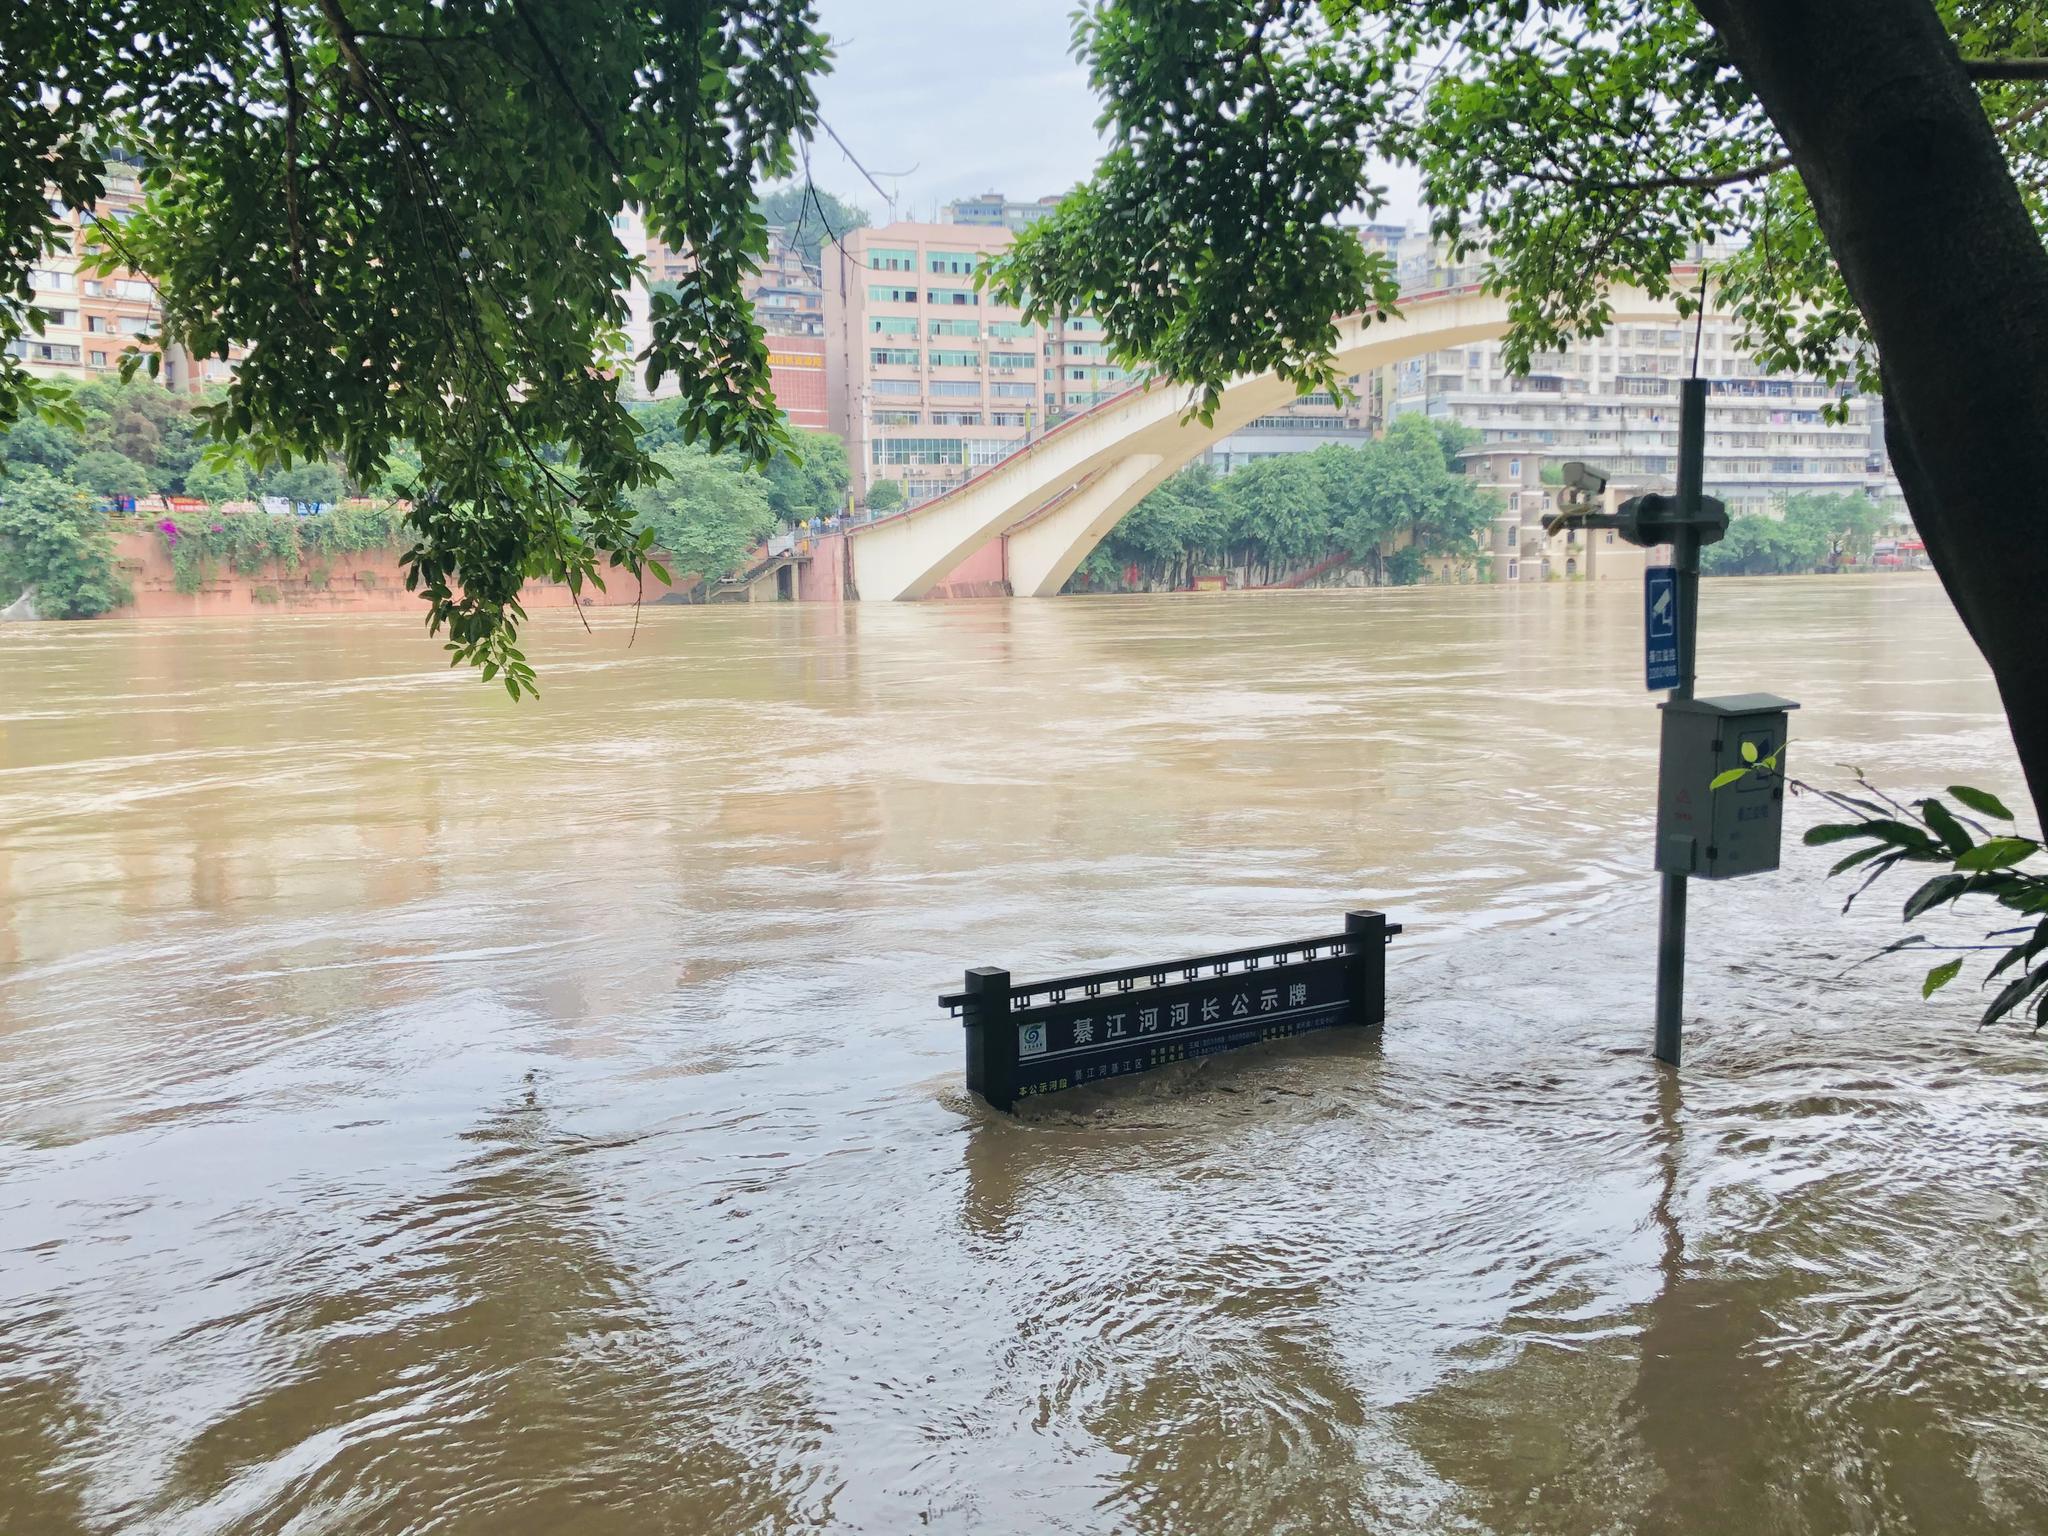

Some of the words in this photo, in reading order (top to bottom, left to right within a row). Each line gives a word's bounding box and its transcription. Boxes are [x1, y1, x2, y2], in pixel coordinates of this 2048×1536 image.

[1072, 982, 1307, 1044] 綦江河河长公示牌
